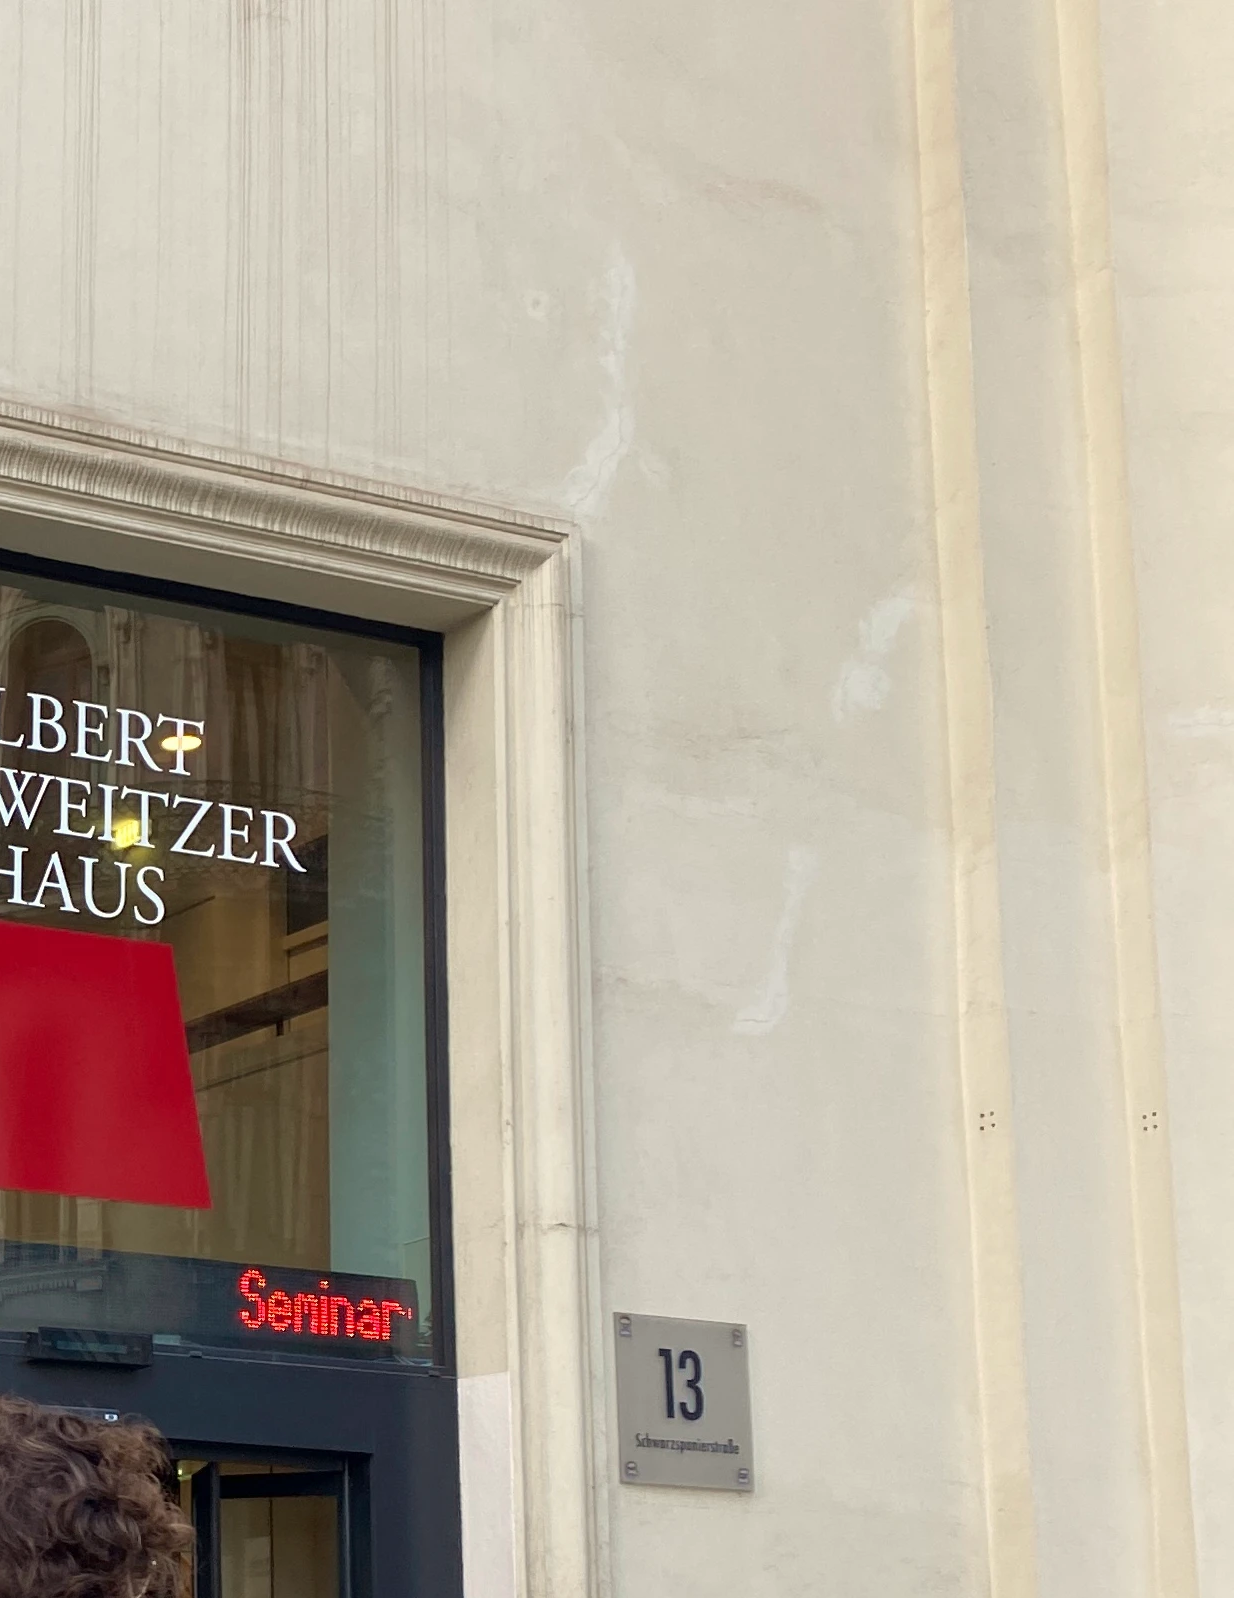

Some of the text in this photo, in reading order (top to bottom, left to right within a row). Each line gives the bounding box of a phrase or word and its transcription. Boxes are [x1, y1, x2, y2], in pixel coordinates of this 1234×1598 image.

[239, 1267, 413, 1340] Seminar
[658, 1348, 704, 1421] 13
[635, 1432, 739, 1454] Schwarzspanierstraße
